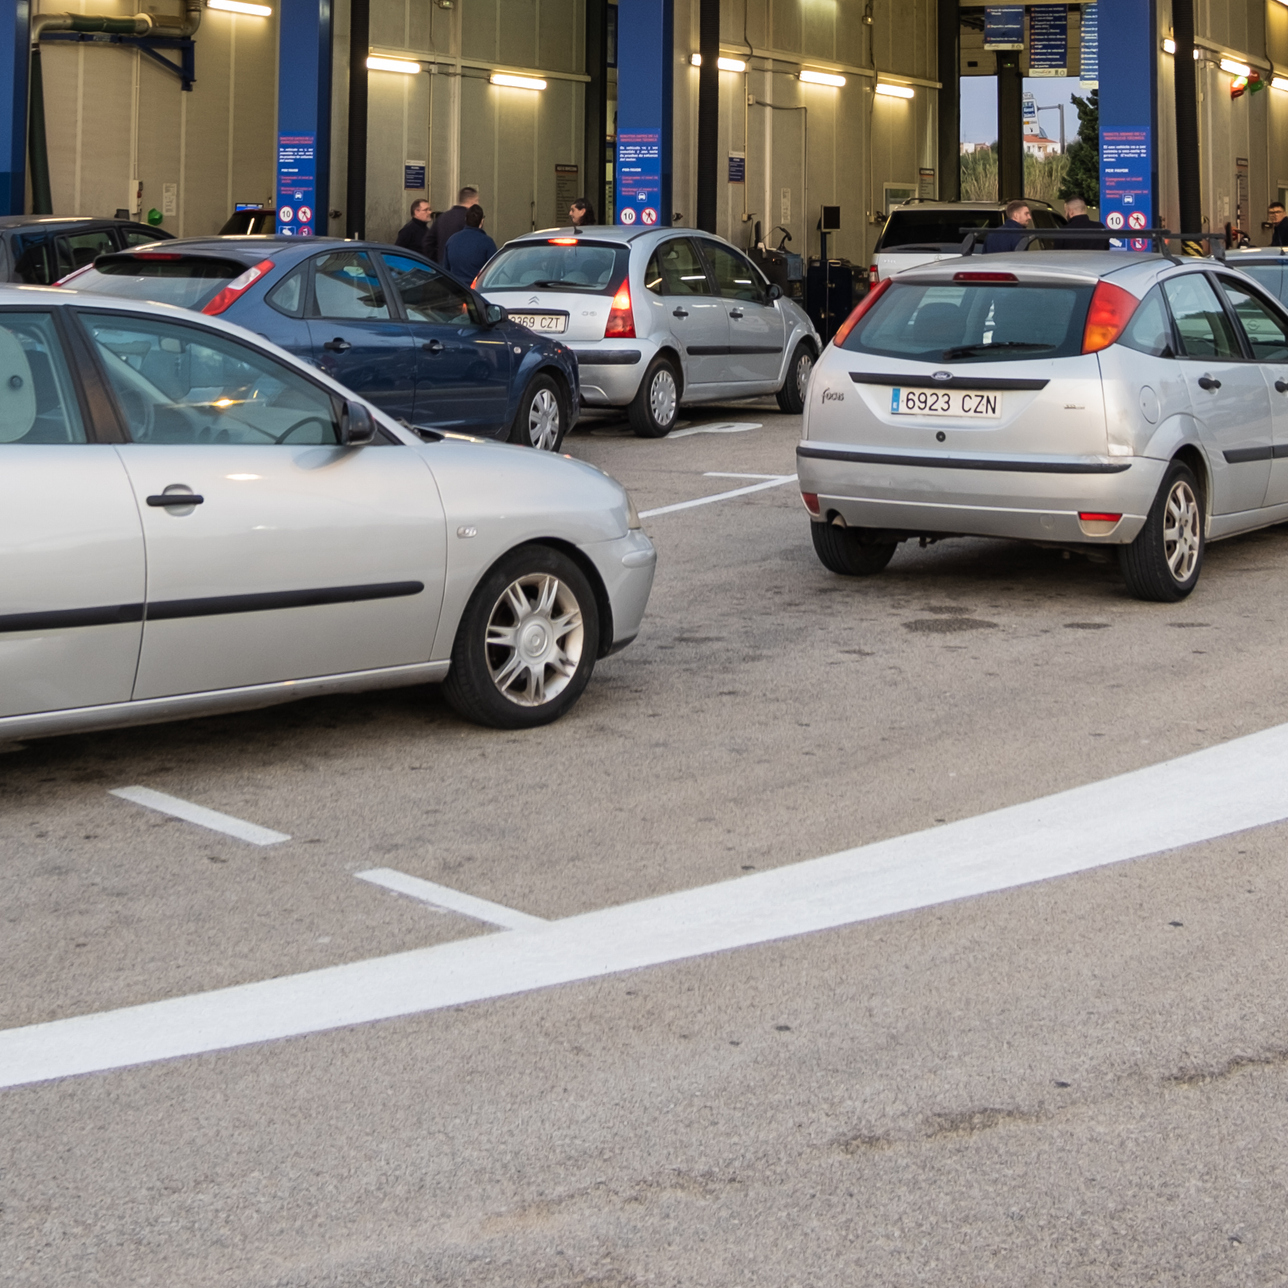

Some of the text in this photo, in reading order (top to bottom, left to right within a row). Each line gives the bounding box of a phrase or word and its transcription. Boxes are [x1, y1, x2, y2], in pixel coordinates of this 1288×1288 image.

[282, 210, 291, 218] 10
[624, 212, 633, 220] 10
[1110, 216, 1121, 225] 10
[540, 317, 560, 329] CZT
[905, 391, 997, 415] 6923 CZN
